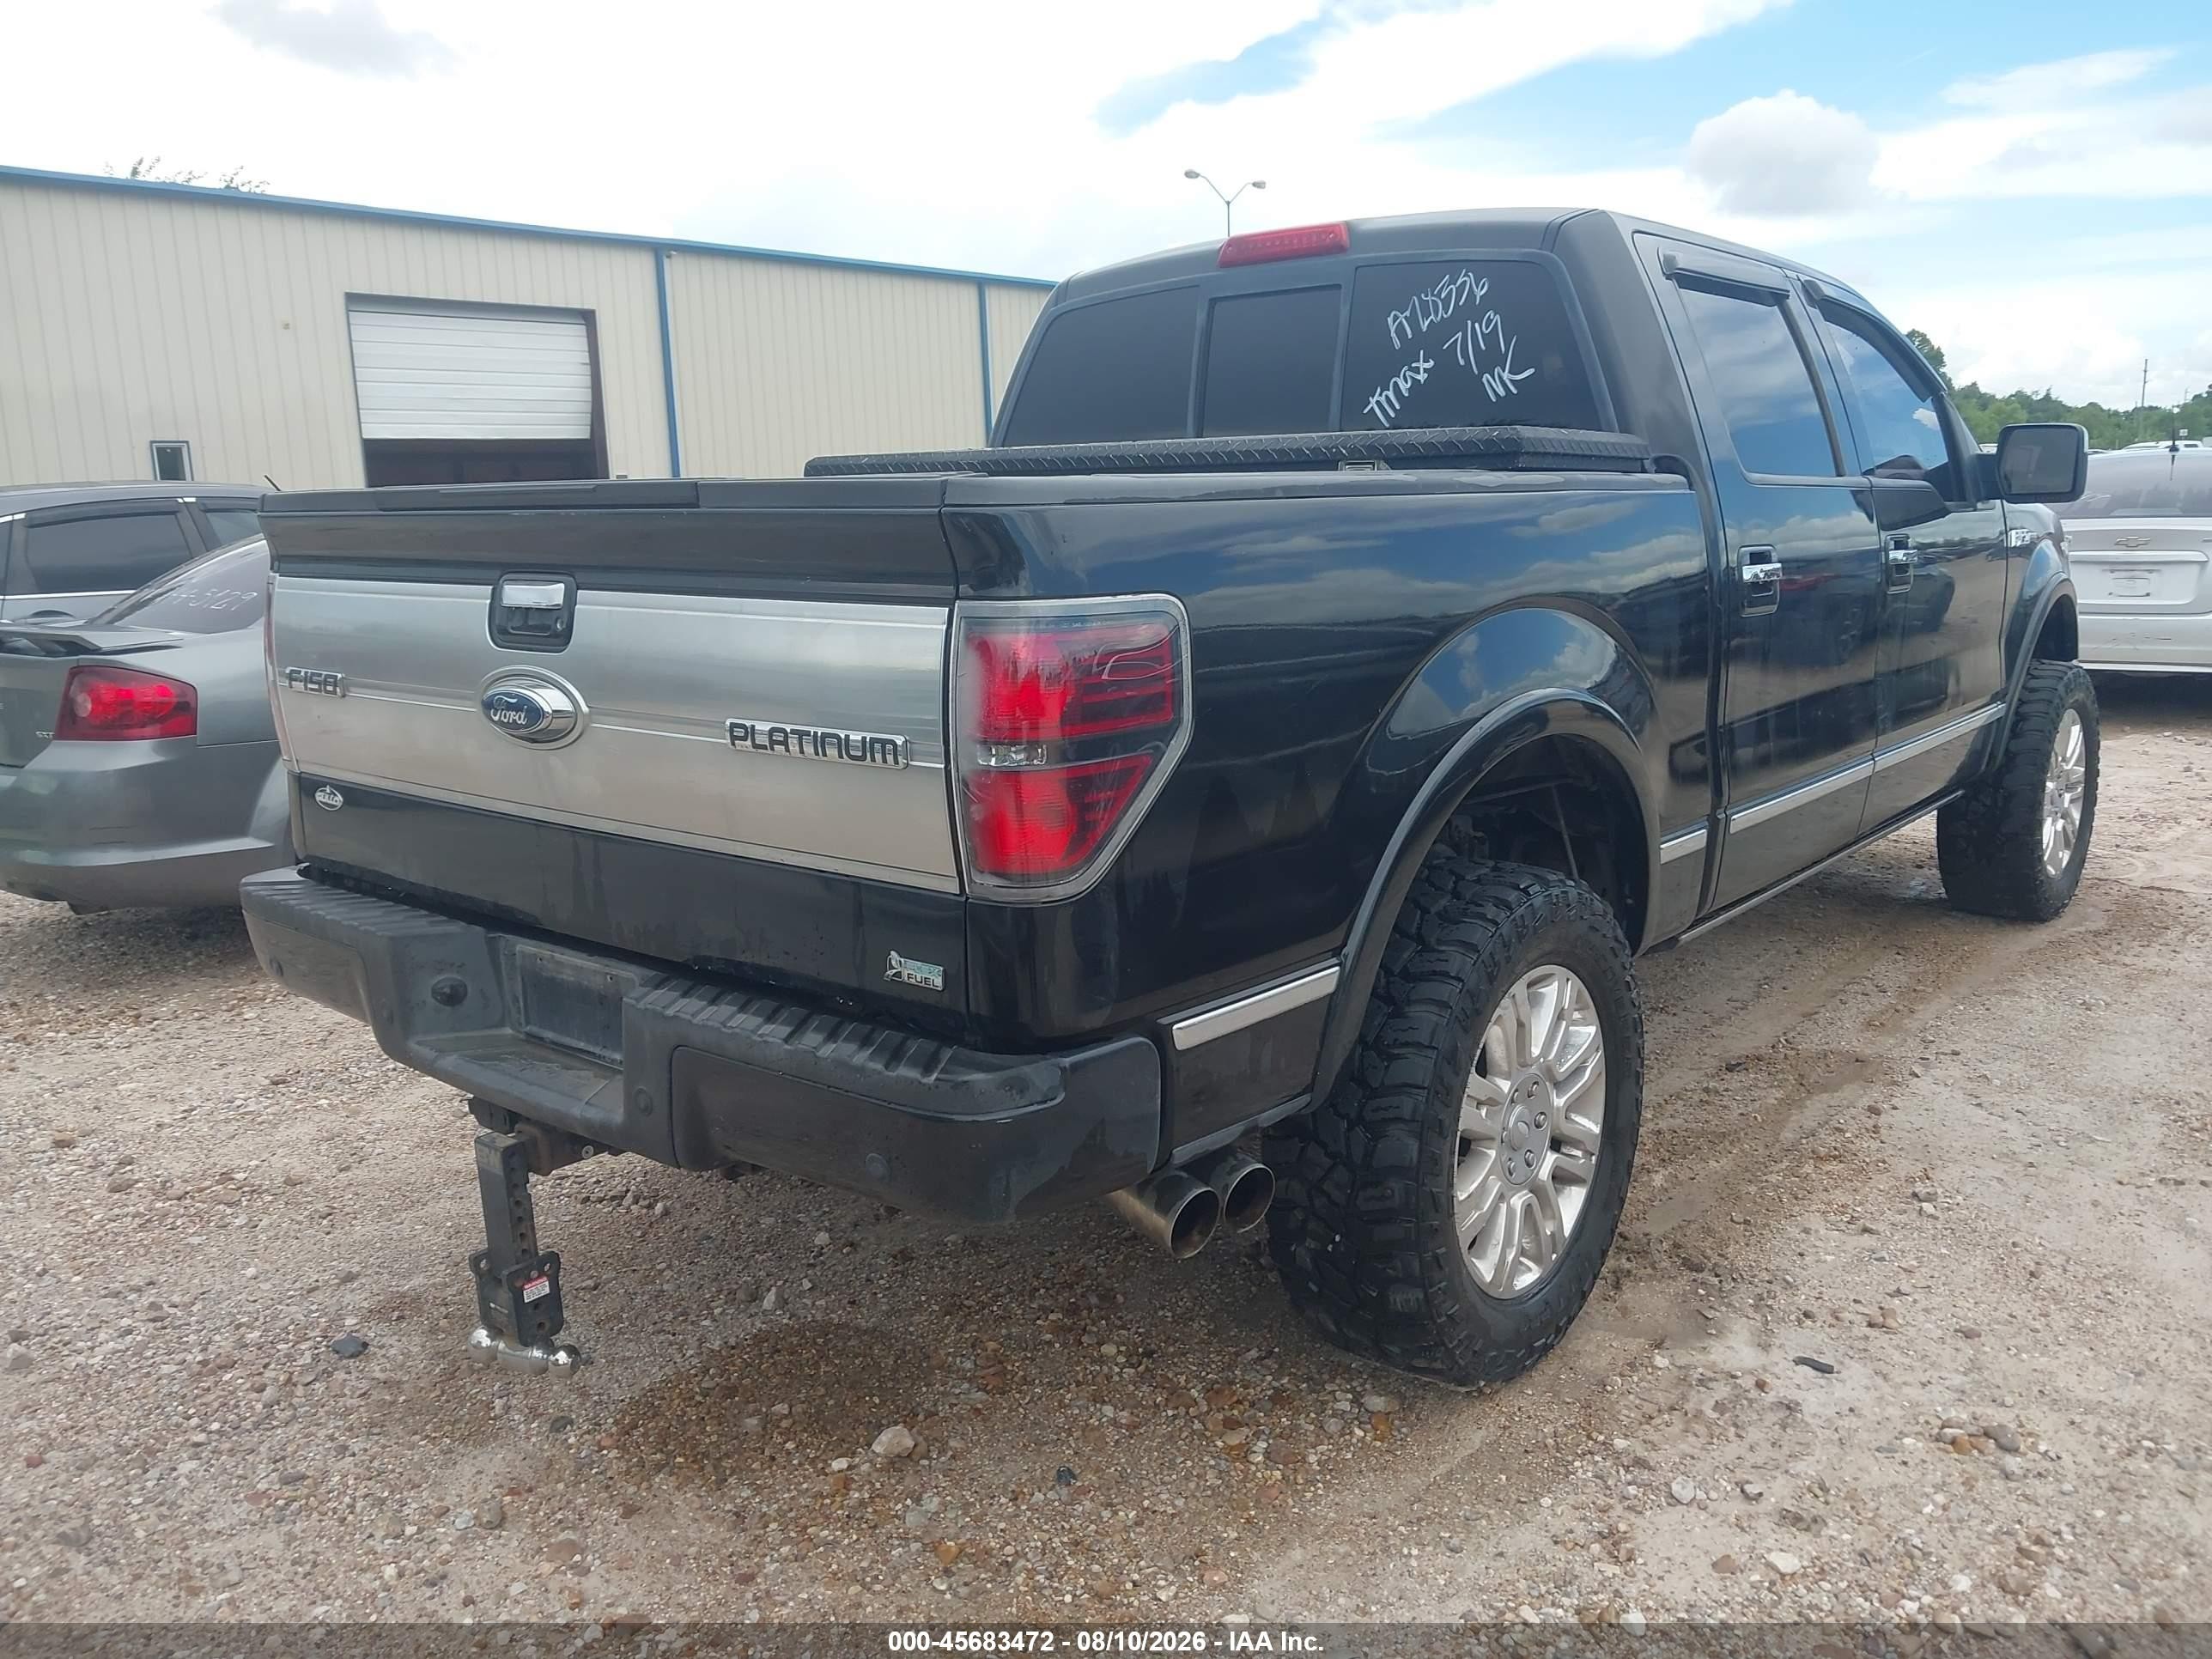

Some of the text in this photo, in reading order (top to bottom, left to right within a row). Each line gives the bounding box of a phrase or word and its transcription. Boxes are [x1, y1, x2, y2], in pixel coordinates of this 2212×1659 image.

[1442, 309, 1505, 375] 7/19
[490, 695, 528, 725] Ford
[729, 721, 900, 766] PLATINUM
[906, 972, 939, 988] FUEL
